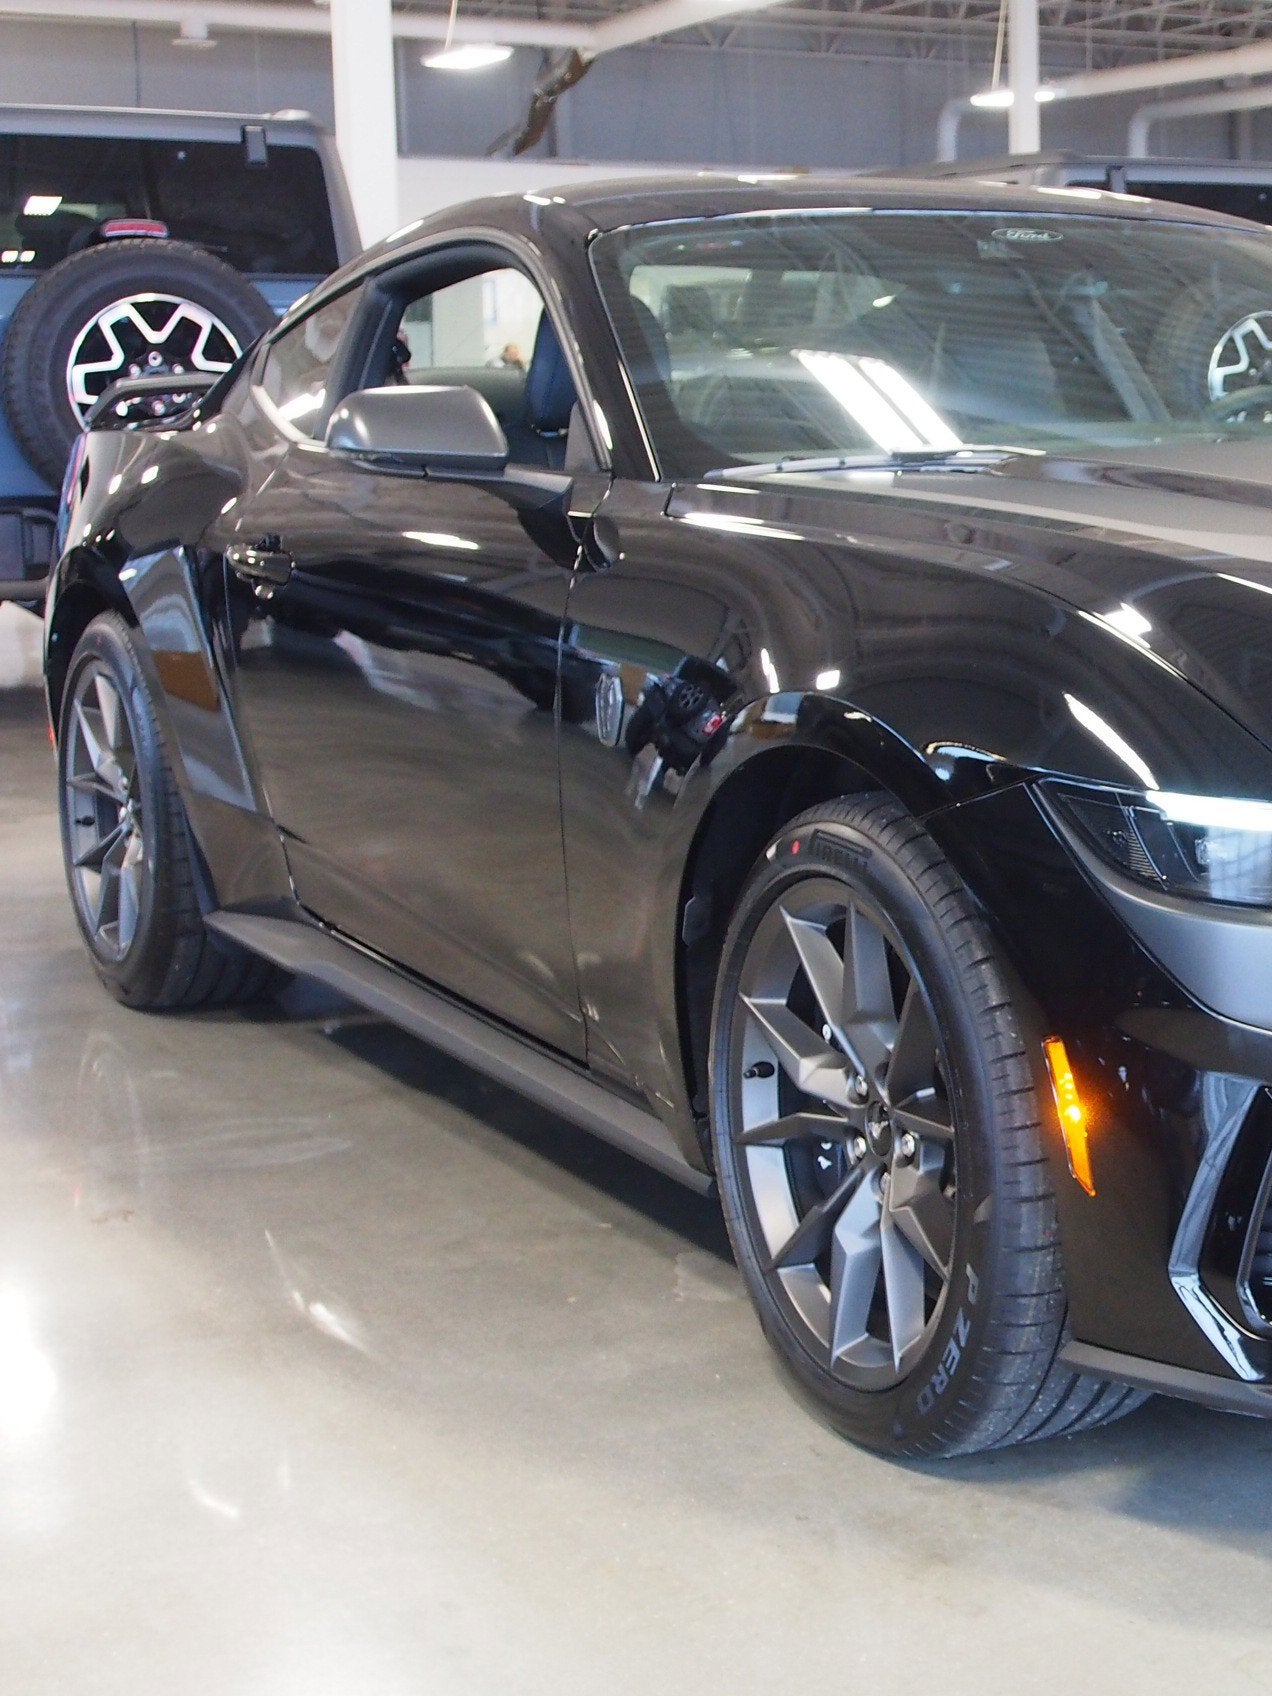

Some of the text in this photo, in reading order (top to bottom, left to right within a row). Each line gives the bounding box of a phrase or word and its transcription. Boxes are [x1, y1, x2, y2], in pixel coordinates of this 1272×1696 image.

[1004, 228, 1052, 242] Ford
[916, 1262, 980, 1416] P ZERO
